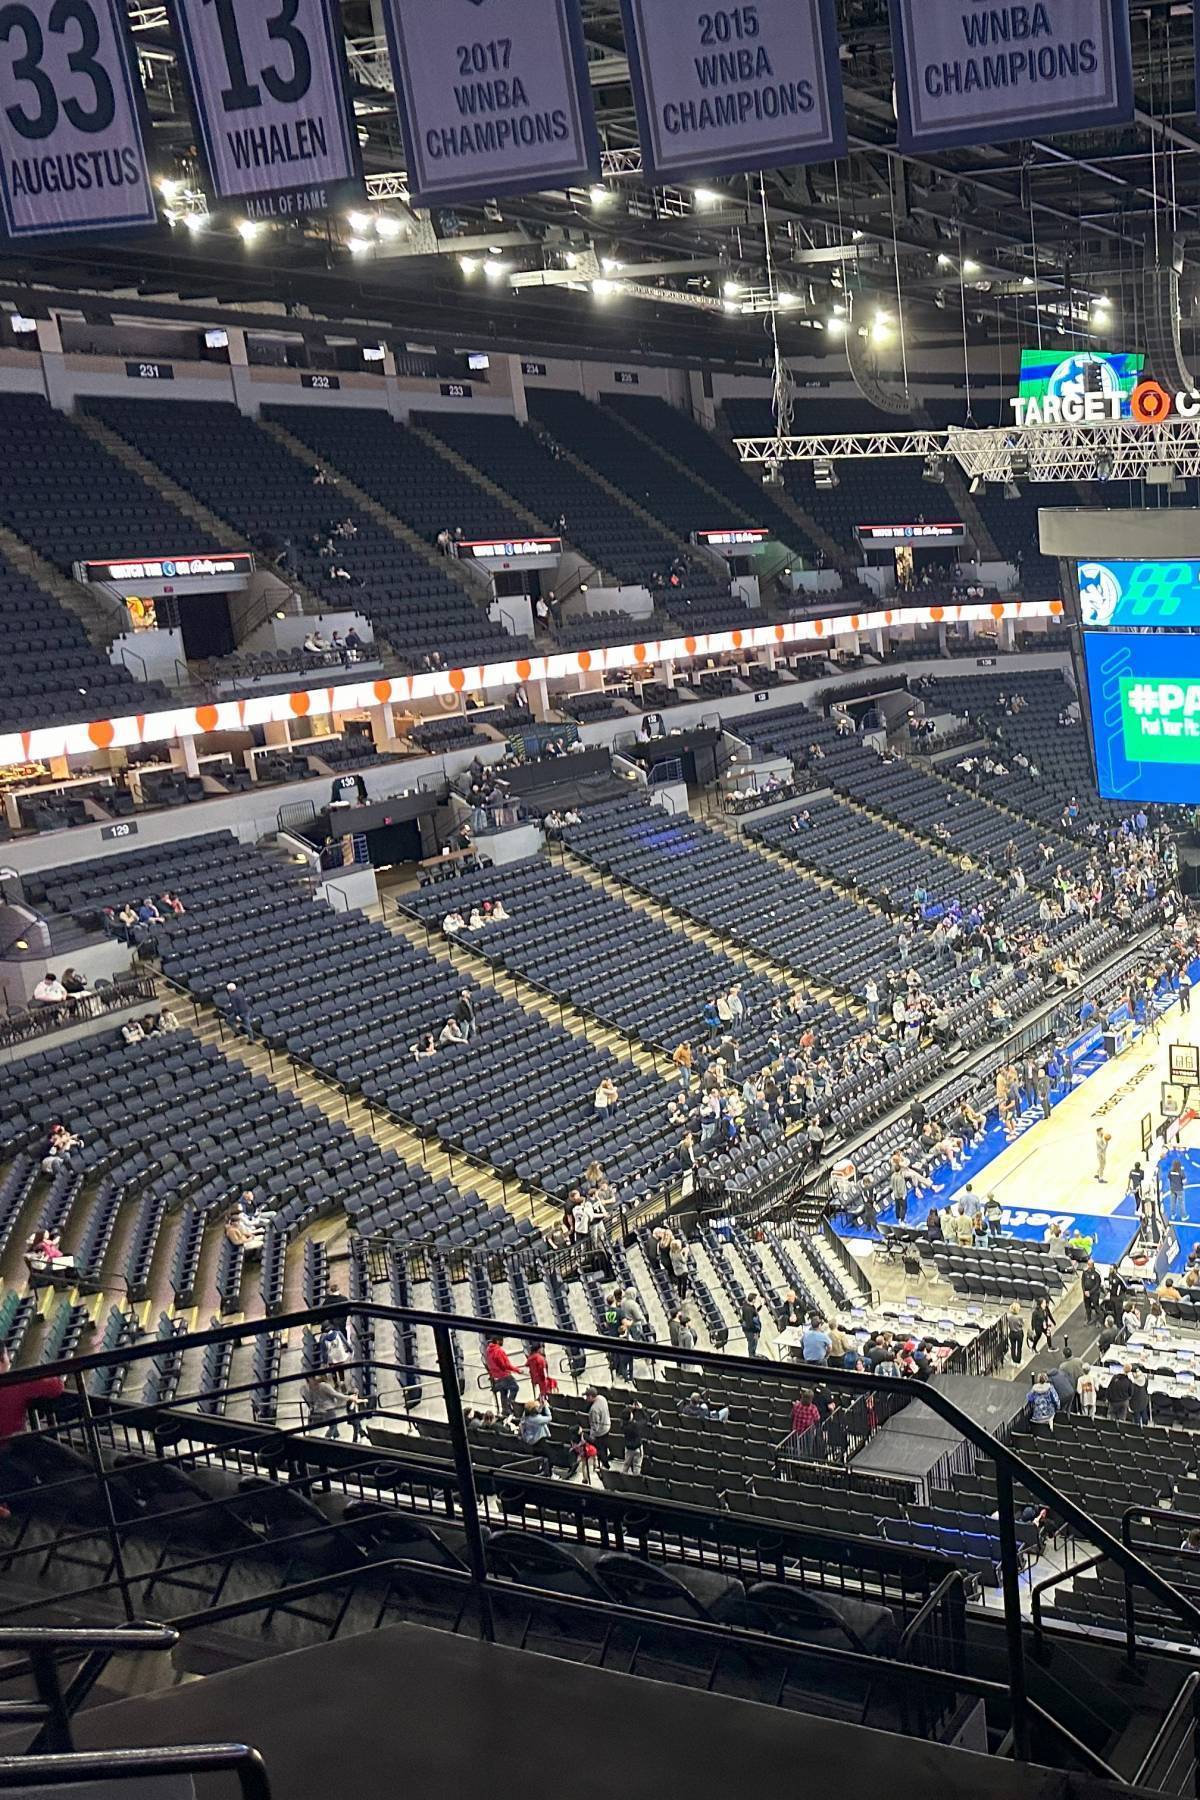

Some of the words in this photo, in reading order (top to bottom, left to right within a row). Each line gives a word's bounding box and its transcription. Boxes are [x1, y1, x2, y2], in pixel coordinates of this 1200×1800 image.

[698, 6, 760, 46] 2015
[962, 3, 1053, 47] WNBA
[0, 2, 116, 140] 33
[196, 0, 312, 112] 13
[456, 38, 512, 75] 2017
[694, 46, 773, 89] WNBA
[924, 38, 1098, 97] CHAMPIONS
[453, 76, 529, 116] WNBA
[663, 79, 815, 135] CHAMPIONS
[227, 117, 328, 169] WHALEN
[426, 110, 569, 159] CHAMPIONS
[12, 147, 140, 197] AUGUSTUS
[246, 200, 276, 218] HALL
[279, 195, 295, 212] OF
[297, 190, 328, 210] FAME
[140, 364, 159, 378] 231
[312, 376, 330, 388] 232
[449, 385, 464, 396] 233
[1010, 391, 1128, 426] TARGET
[340, 777, 355, 787] 130
[111, 824, 130, 837] 129
